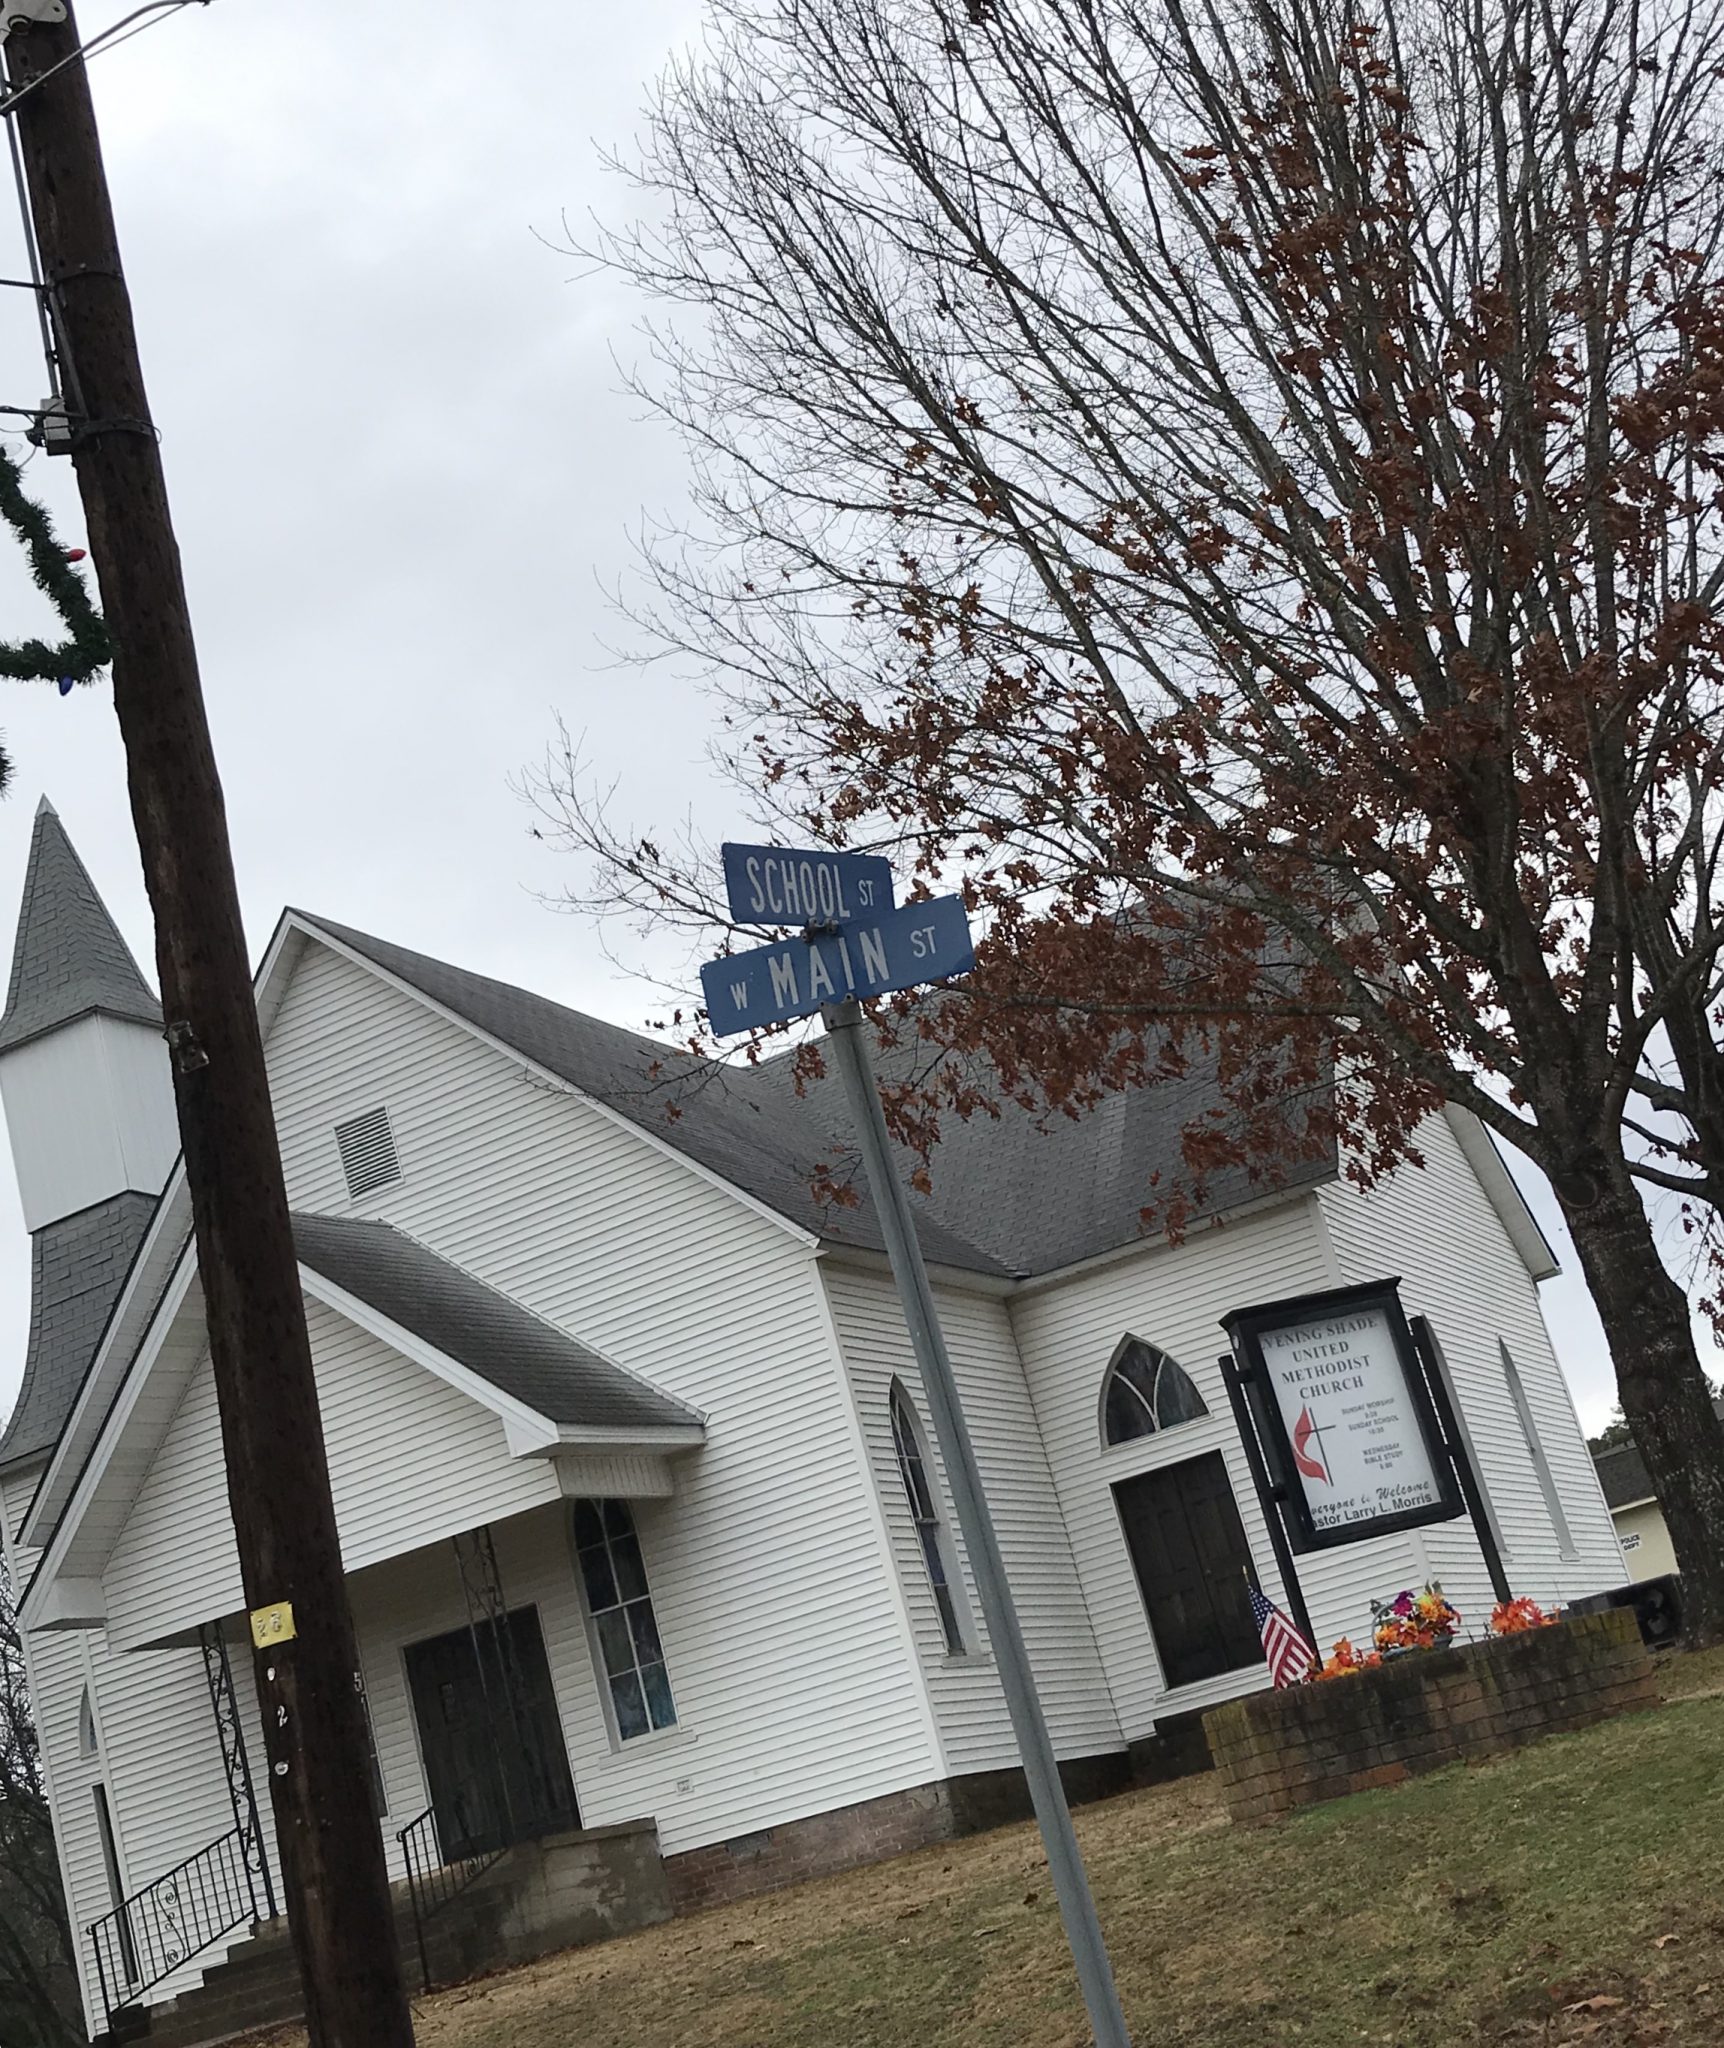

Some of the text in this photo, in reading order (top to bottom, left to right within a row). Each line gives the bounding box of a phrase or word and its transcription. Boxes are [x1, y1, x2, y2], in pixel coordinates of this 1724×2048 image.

[746, 856, 874, 918] SCHOOL ST
[730, 925, 936, 1011] W MAIN ST
[1262, 1317, 1377, 1350] VENING SHADE
[1292, 1341, 1349, 1363] UNITED
[1281, 1355, 1370, 1384] METHODIST
[1299, 1375, 1364, 1399] CHURCH
[1311, 1497, 1355, 1515] veryone
[1375, 1480, 1430, 1500] Welcome
[1312, 1493, 1432, 1528] astor Larry L. Morris
[1620, 1534, 1640, 1545] POLICE
